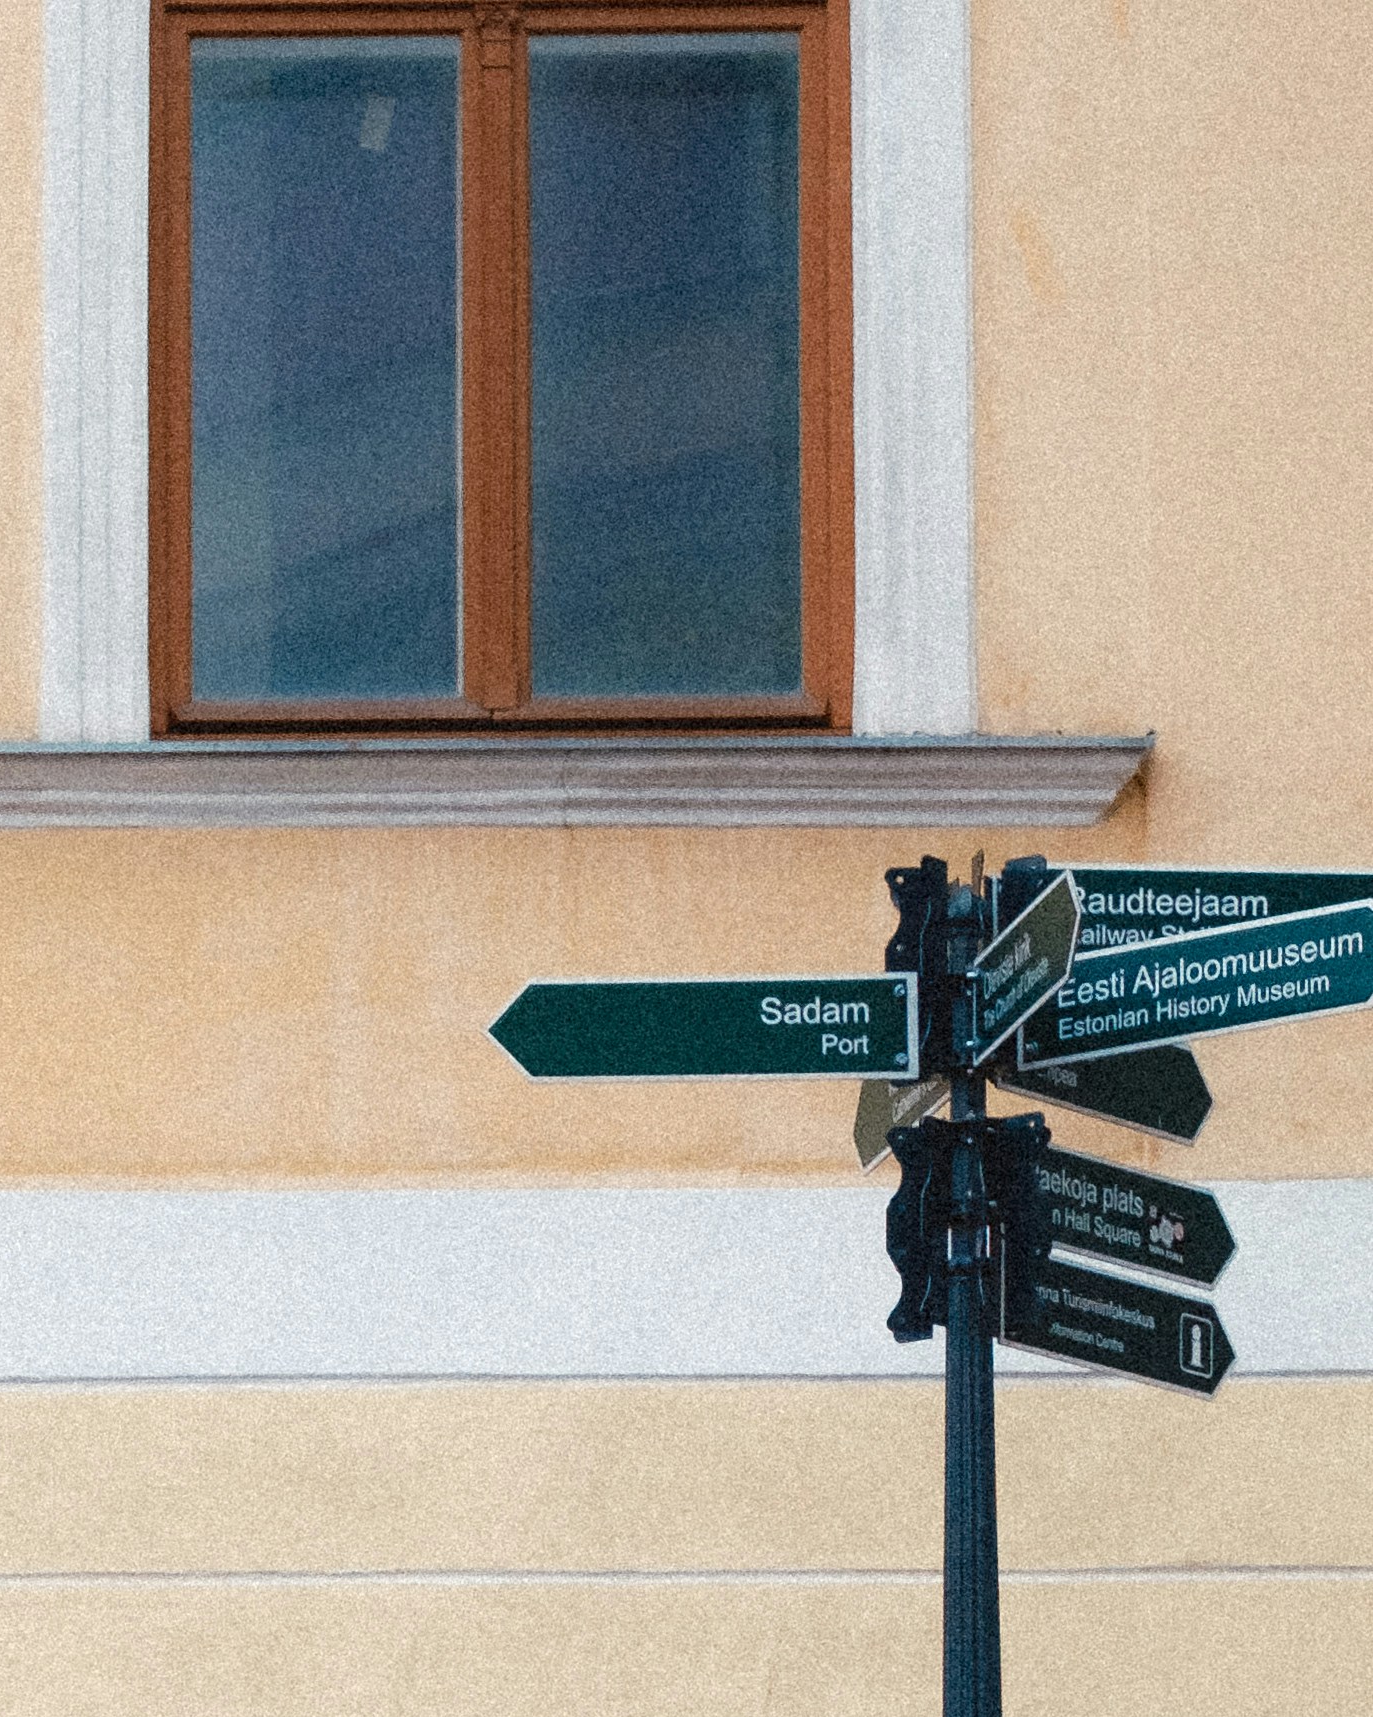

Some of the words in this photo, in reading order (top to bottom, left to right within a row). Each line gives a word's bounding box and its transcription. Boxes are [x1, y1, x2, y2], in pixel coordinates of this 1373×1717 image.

[1077, 923, 1153, 945] ailway
[1057, 968, 1125, 1008] Eesti
[1132, 931, 1363, 998] Ajaloomuuseum
[760, 996, 870, 1025] Sadam
[1059, 1008, 1149, 1040] Estonian
[1156, 992, 1230, 1022] History
[1237, 974, 1330, 1008] Museum
[821, 1033, 870, 1056] Port
[1035, 1165, 1097, 1207] aekoja
[1102, 1183, 1144, 1218] plats
[1064, 1206, 1091, 1233] Hall
[1094, 1215, 1142, 1246] Square
